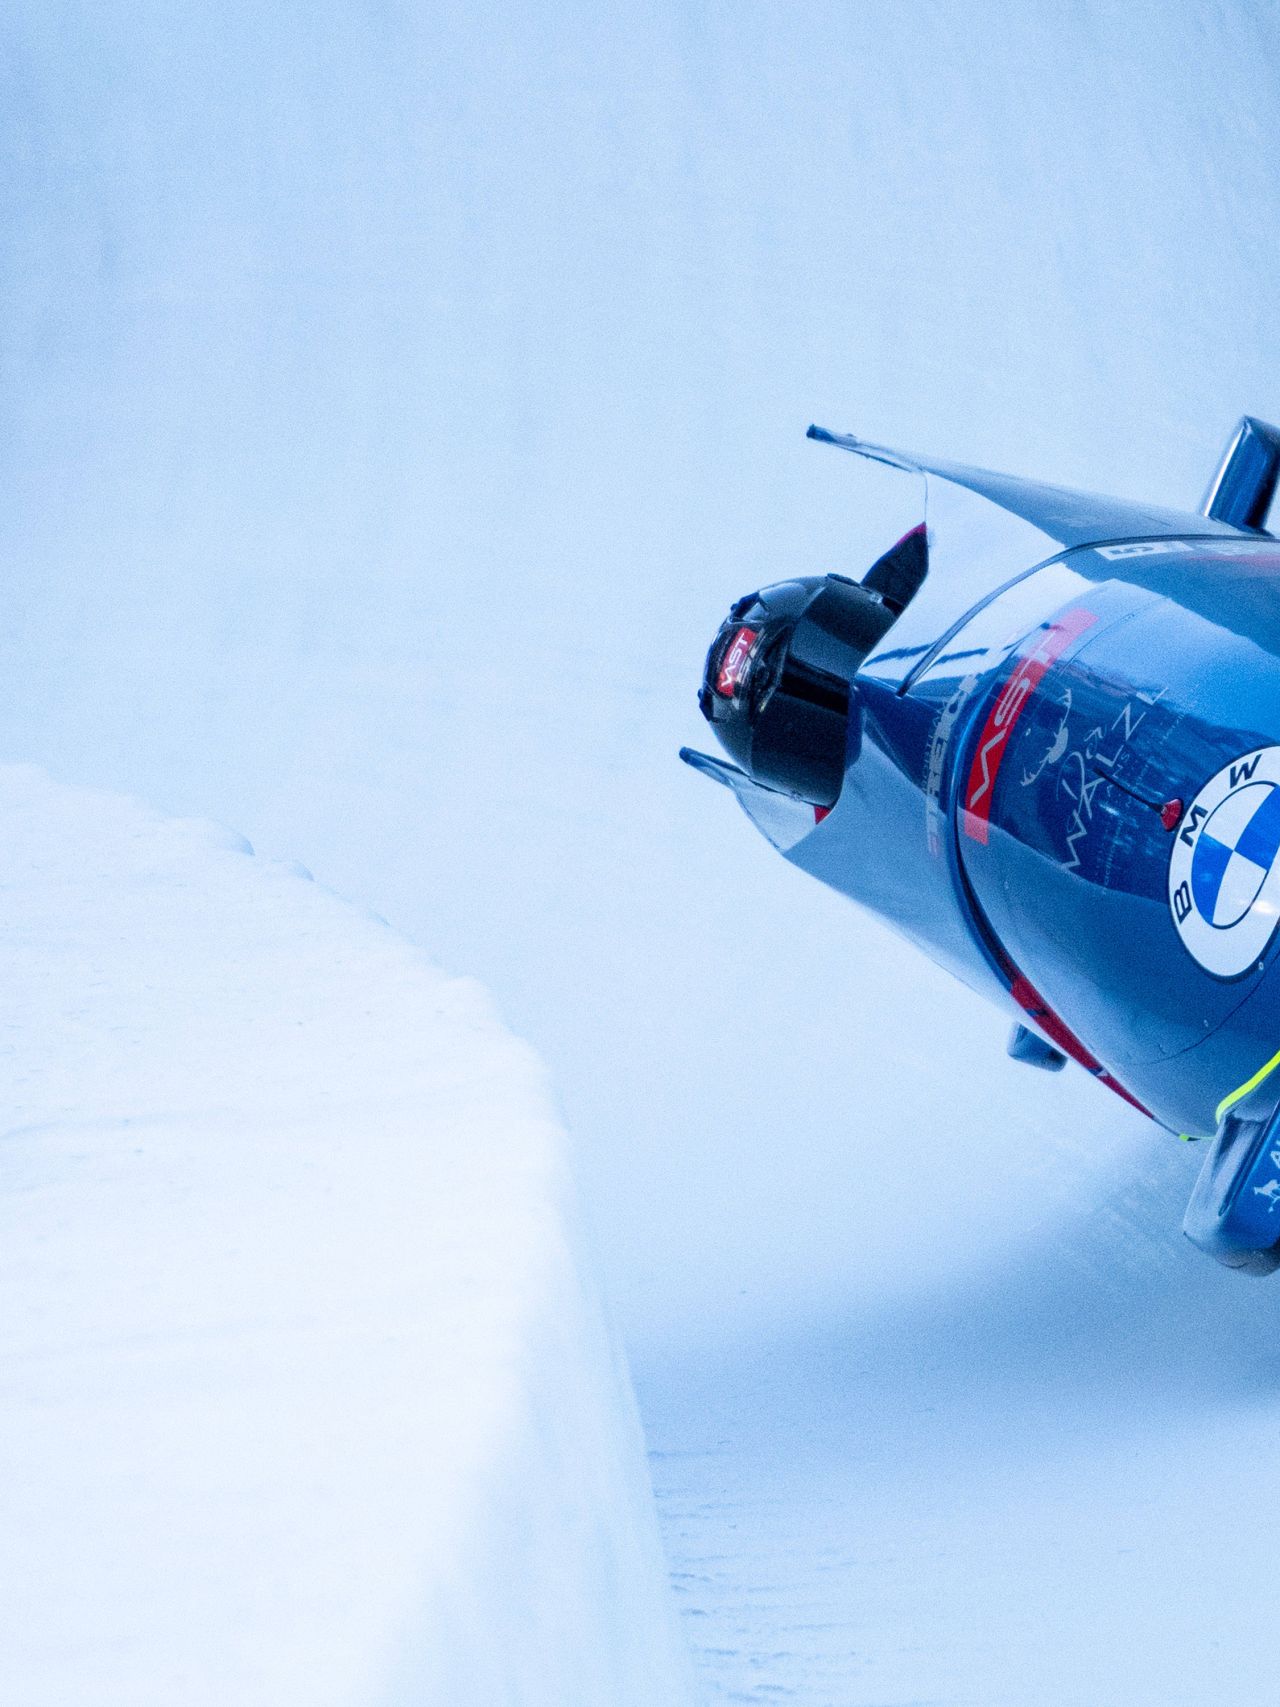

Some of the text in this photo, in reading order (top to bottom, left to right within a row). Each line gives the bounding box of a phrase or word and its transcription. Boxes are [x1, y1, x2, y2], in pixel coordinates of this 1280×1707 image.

[721, 632, 748, 688] VAST
[969, 630, 1056, 810] VAST
[1062, 687, 1169, 871] WALZL
[1173, 754, 1262, 925] BMW
